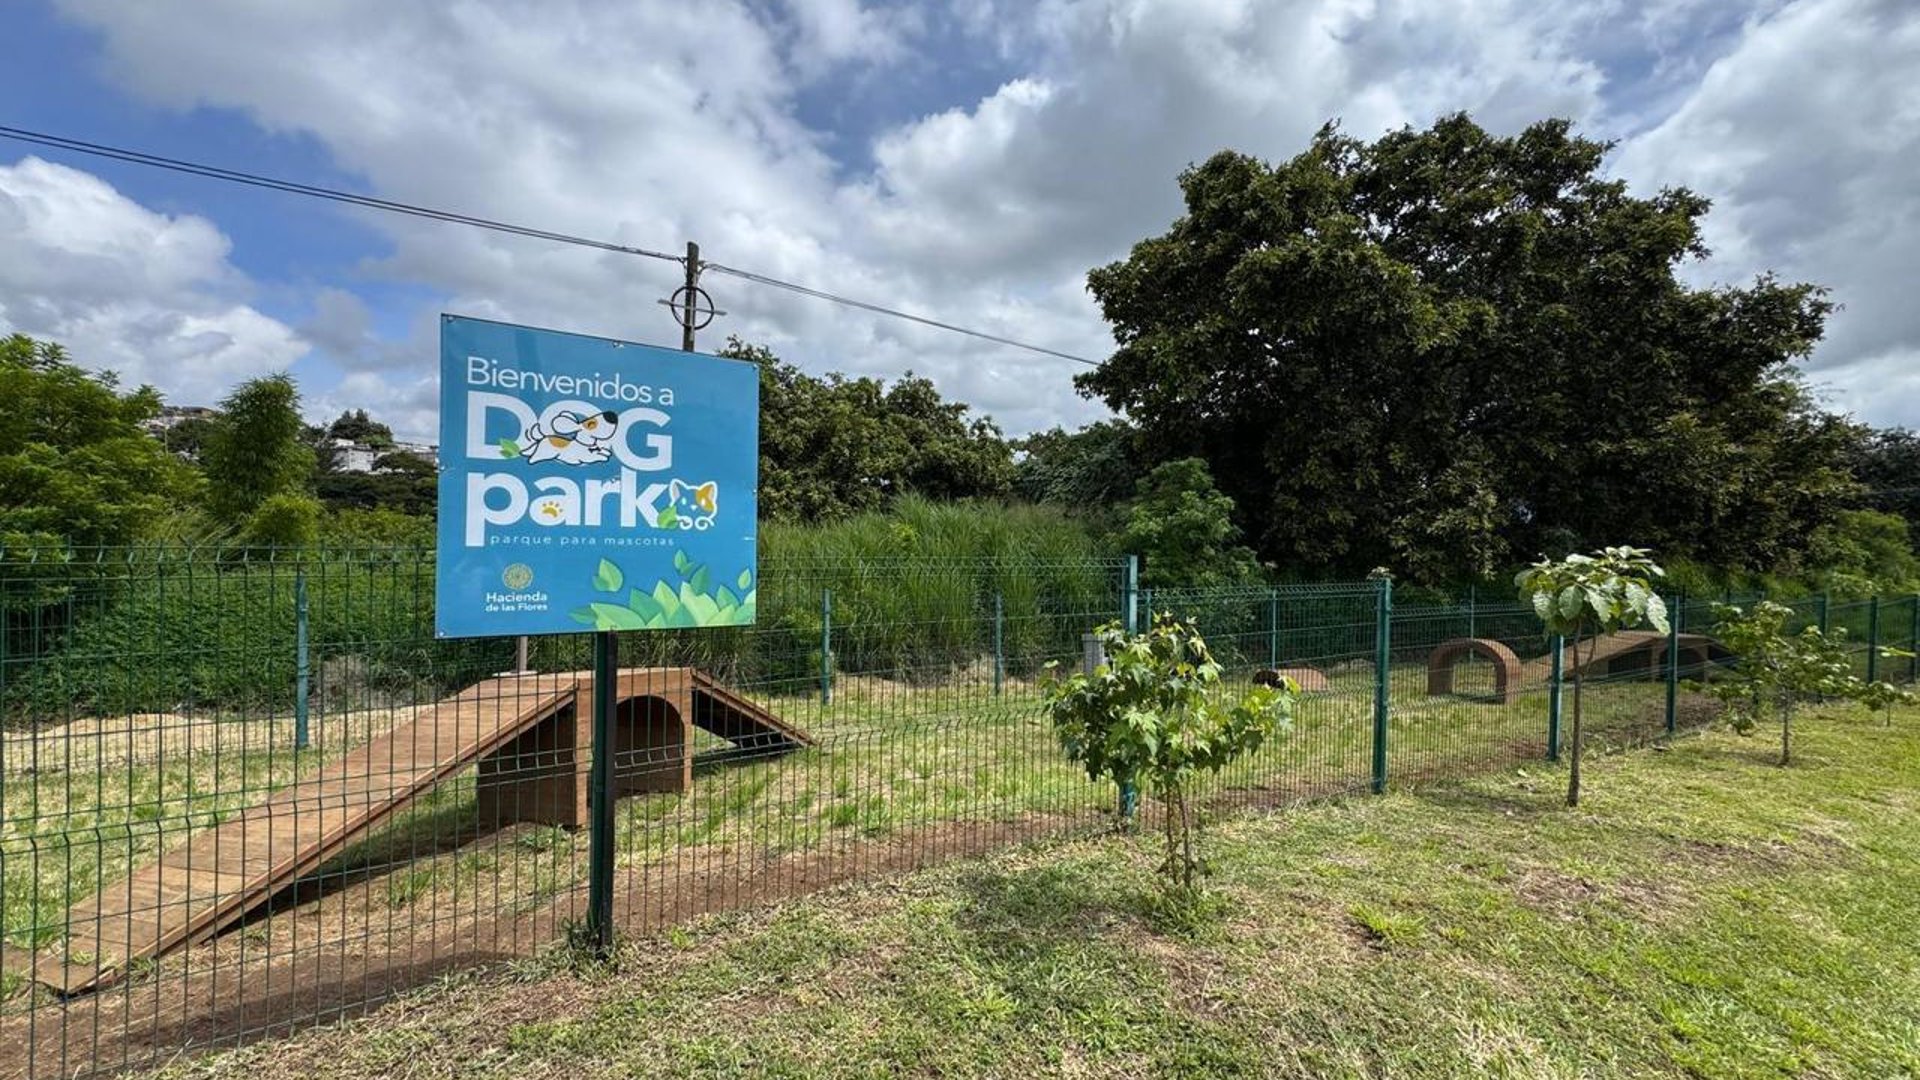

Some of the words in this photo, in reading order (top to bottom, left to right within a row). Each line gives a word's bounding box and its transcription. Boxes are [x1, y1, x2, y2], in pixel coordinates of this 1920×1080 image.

[467, 356, 651, 403] Bienvenidos
[658, 387, 674, 406] a
[466, 390, 673, 470] DOG
[465, 466, 669, 547] park
[490, 534, 552, 546] parque
[560, 536, 596, 546] para
[604, 535, 674, 546] mascotas
[485, 604, 499, 612] de
[501, 604, 515, 612] las
[518, 603, 548, 612] Flores
[486, 591, 548, 603] Hacienda
